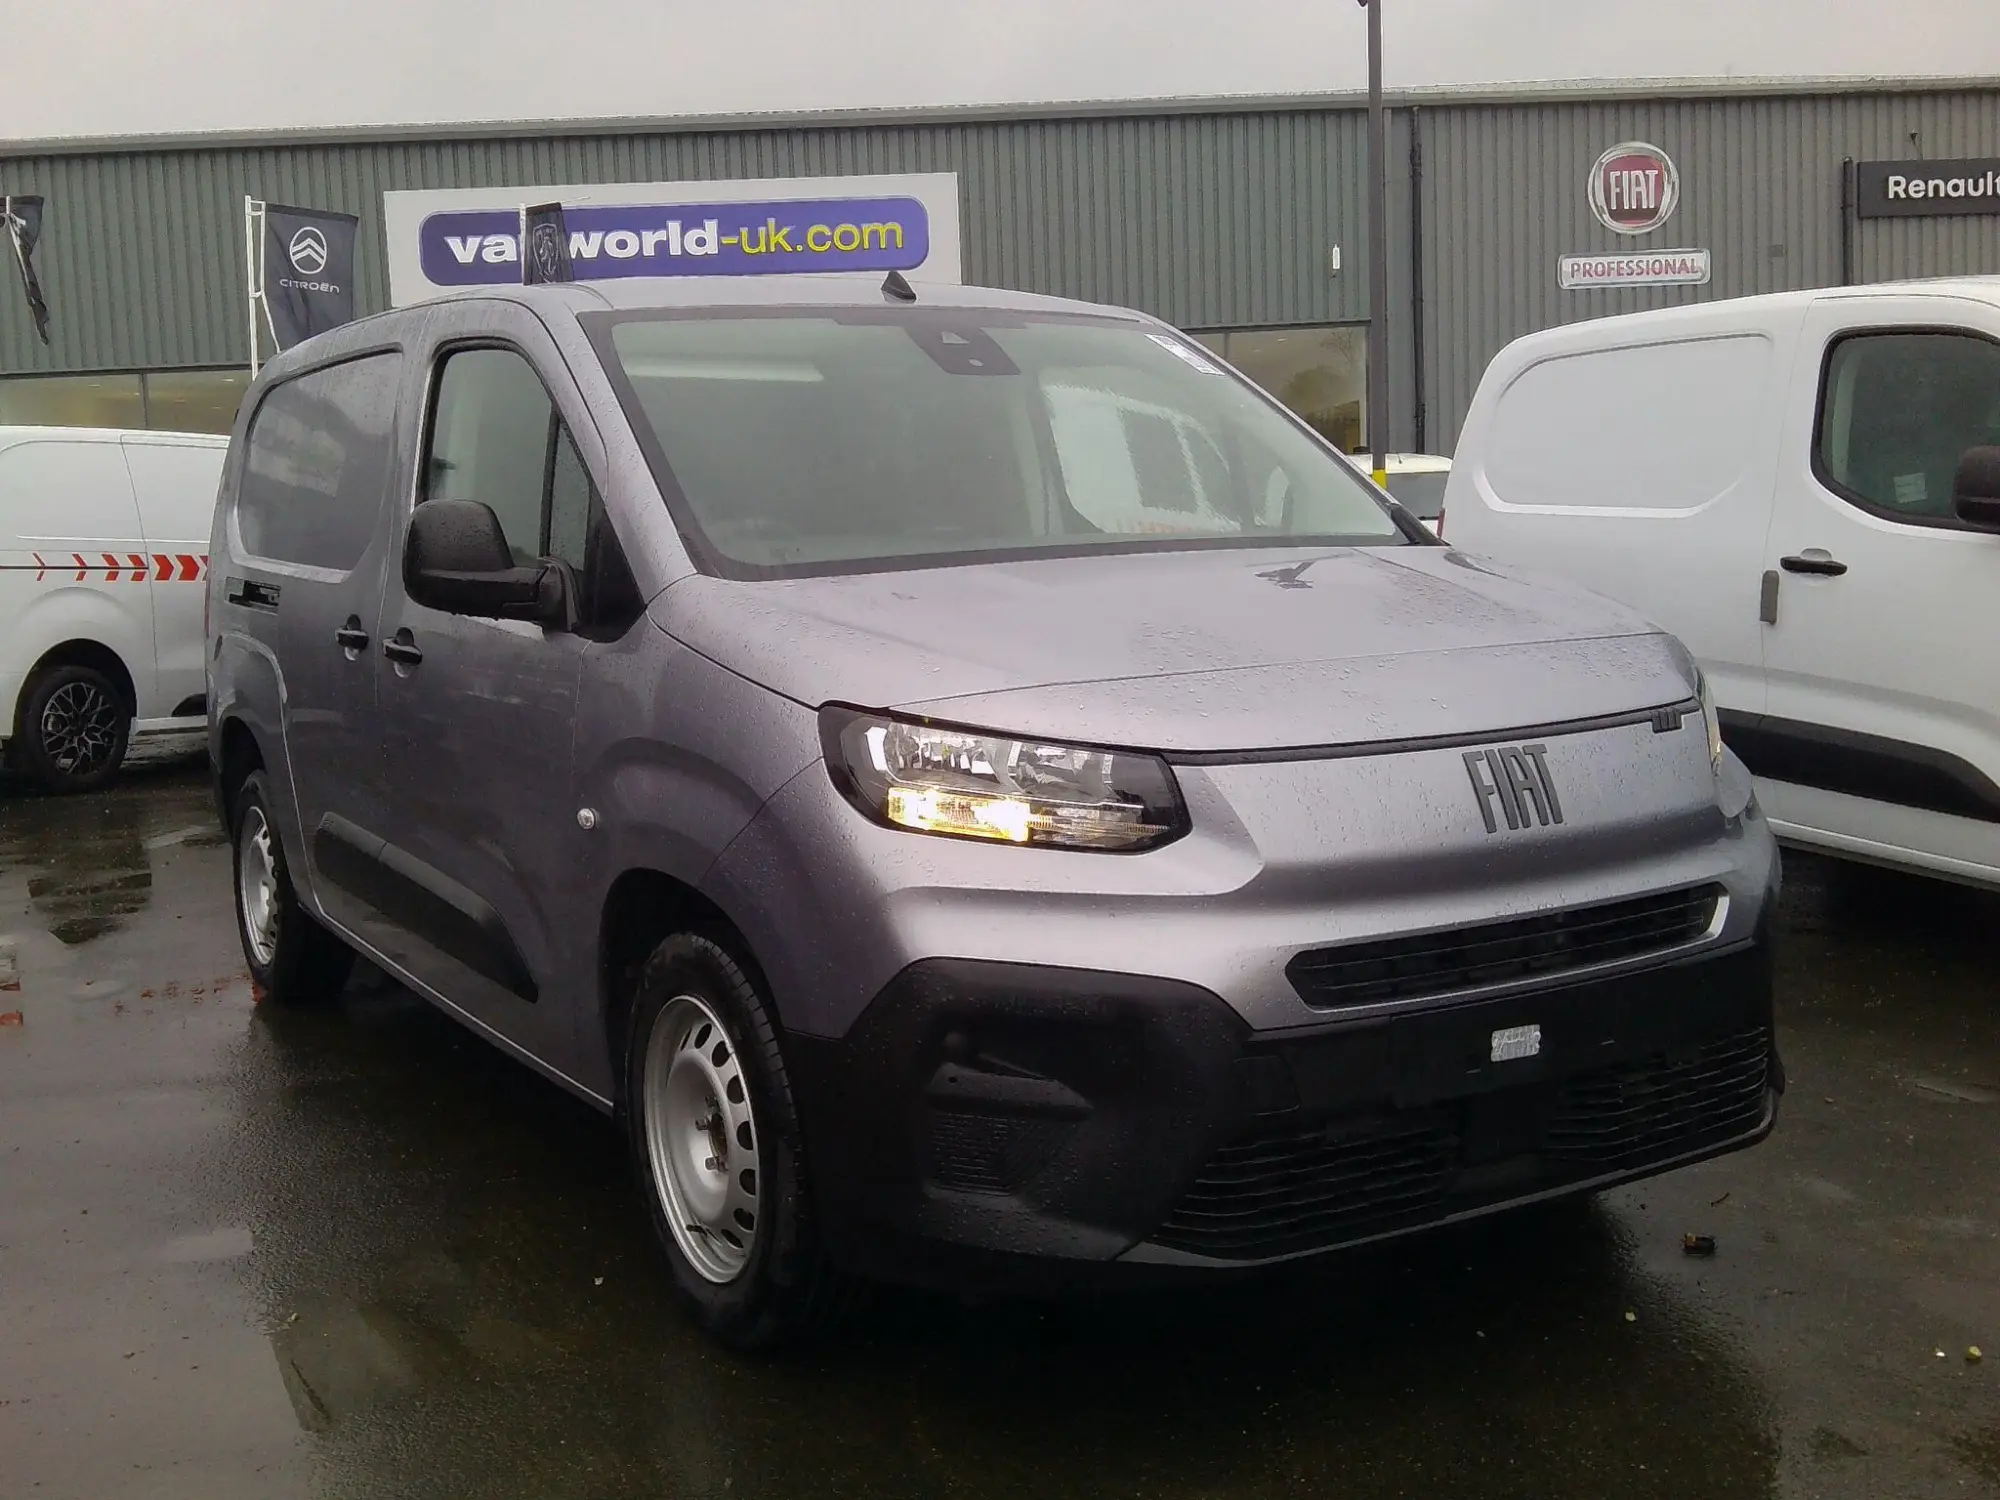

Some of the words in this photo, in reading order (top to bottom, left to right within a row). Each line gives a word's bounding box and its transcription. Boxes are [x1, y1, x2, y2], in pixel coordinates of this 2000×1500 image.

[1609, 170, 1658, 210] FIAT
[444, 217, 904, 263] vaworld-uk.com
[1570, 258, 1699, 278] PROFESSIONAL
[1462, 744, 1563, 833] FIAT
